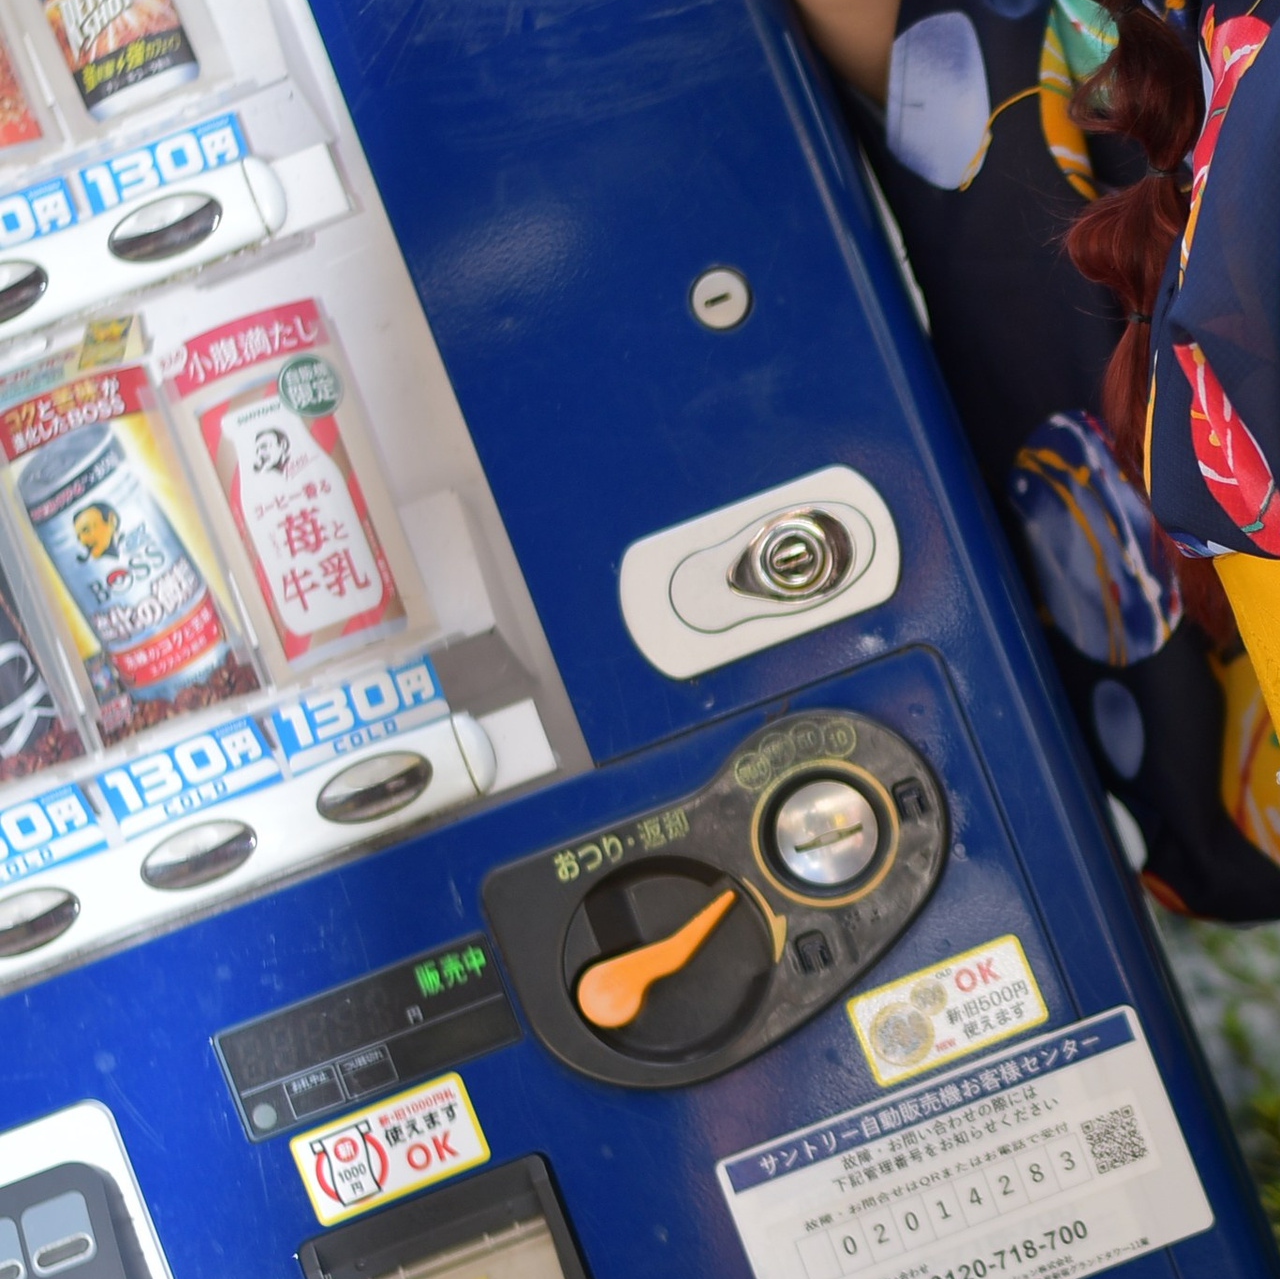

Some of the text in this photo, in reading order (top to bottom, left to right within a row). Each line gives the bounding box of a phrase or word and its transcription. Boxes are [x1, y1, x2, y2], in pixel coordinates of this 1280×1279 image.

[84, 125, 240, 208] 130円
[183, 308, 319, 383] 小腹満たし
[285, 375, 335, 410] 限定
[278, 546, 371, 614] 牛乳
[277, 664, 437, 747] 130円
[331, 718, 399, 755] COLD
[104, 725, 265, 814] 130円
[161, 777, 229, 816] COLD
[0, 793, 88, 860] 0円
[552, 807, 692, 884] おつり・返却
[414, 942, 490, 998] 販売中
[952, 956, 1001, 995] OK
[406, 1004, 424, 1025] 円
[961, 1000, 1027, 1040] 使えます
[935, 1037, 957, 1053] NEW
[383, 1102, 461, 1148] 使えます
[759, 1034, 1100, 1177] サントリー自動販売機お客様センター
[840, 1082, 1040, 1173] 故障・お問い合わせの際には
[333, 1136, 358, 1163] 新
[403, 1129, 459, 1175] OK
[832, 1093, 1061, 1195] 下記管理番号をお知らせください
[338, 1161, 367, 1185] 1000
[350, 1179, 364, 1196] 円
[802, 1119, 1071, 1235] 故障・お問合せはQRまたはお電話で受付
